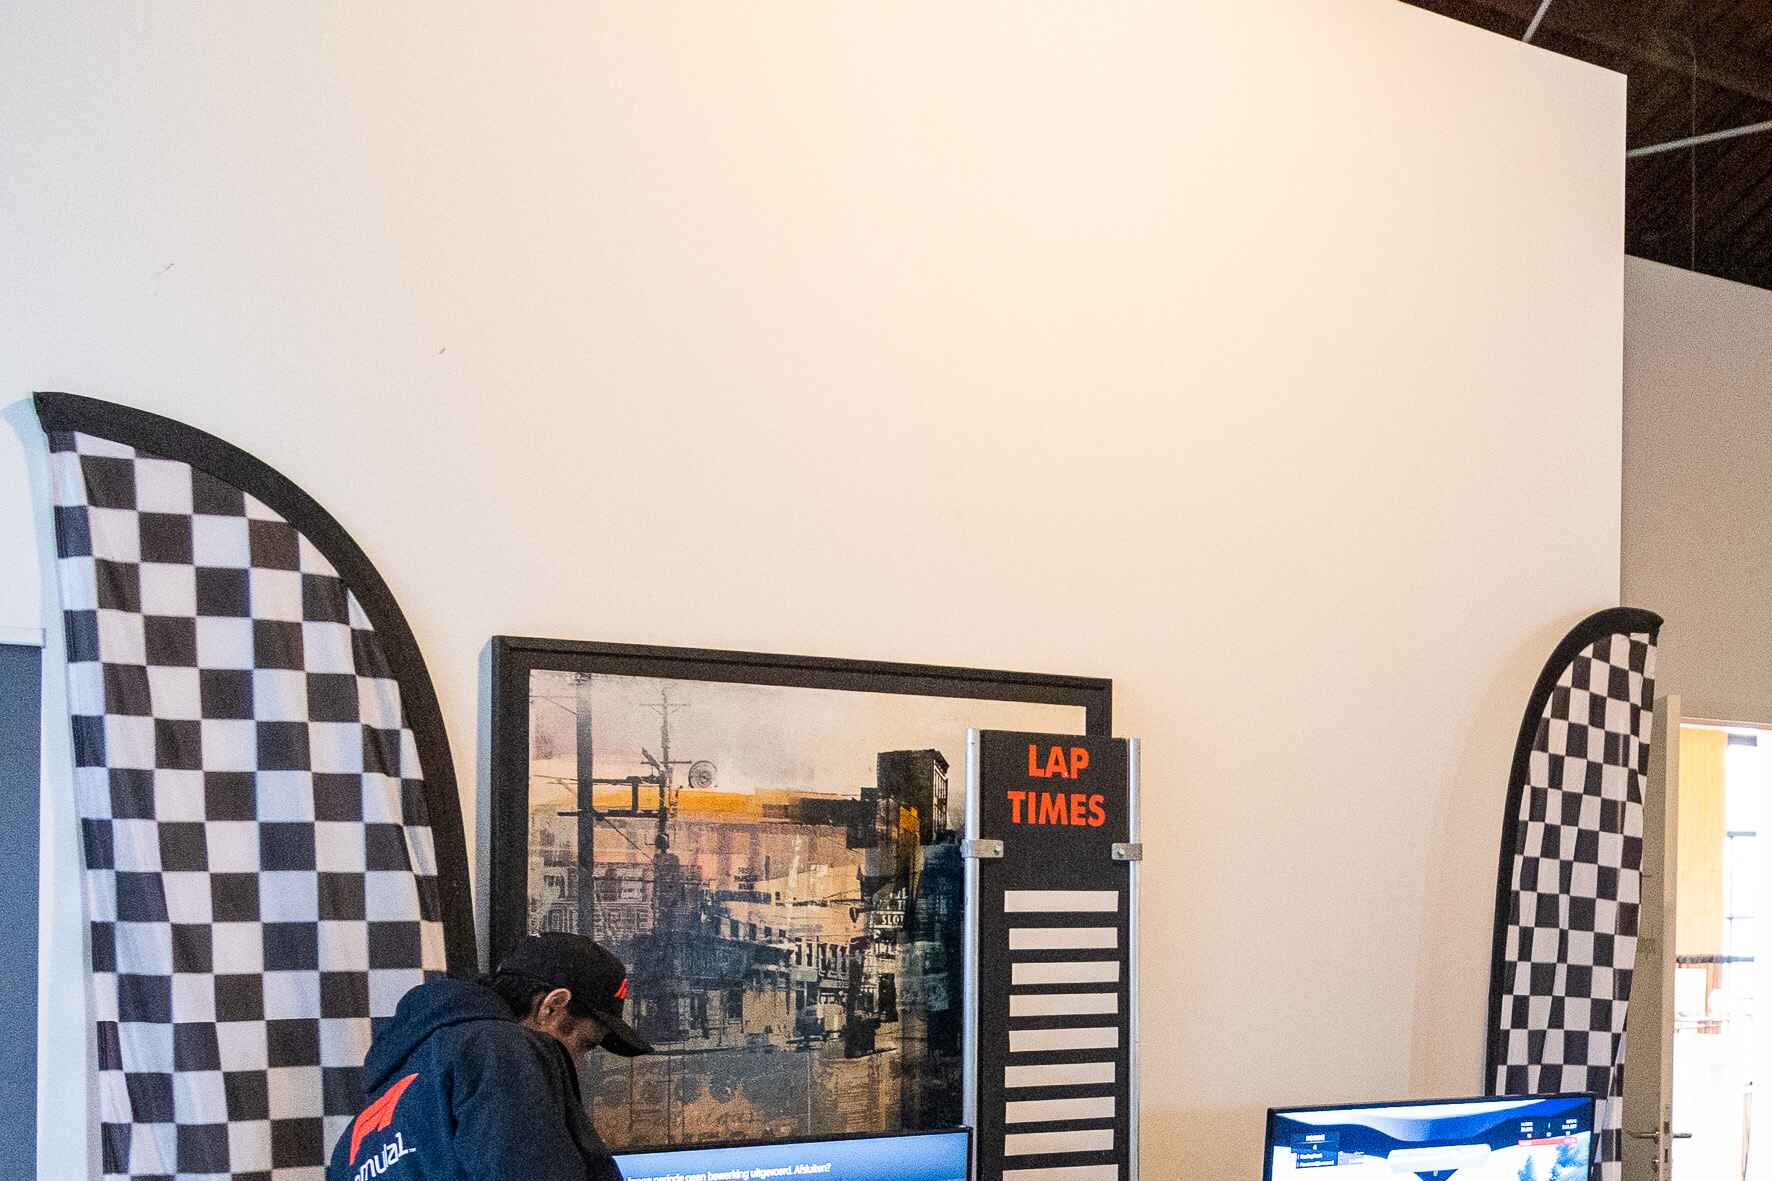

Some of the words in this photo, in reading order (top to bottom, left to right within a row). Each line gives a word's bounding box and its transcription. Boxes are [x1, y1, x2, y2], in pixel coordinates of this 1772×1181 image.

[1028, 744, 1089, 779] LAP
[1007, 790, 1105, 828] TIMES
[707, 1168, 749, 1181] bewerking
